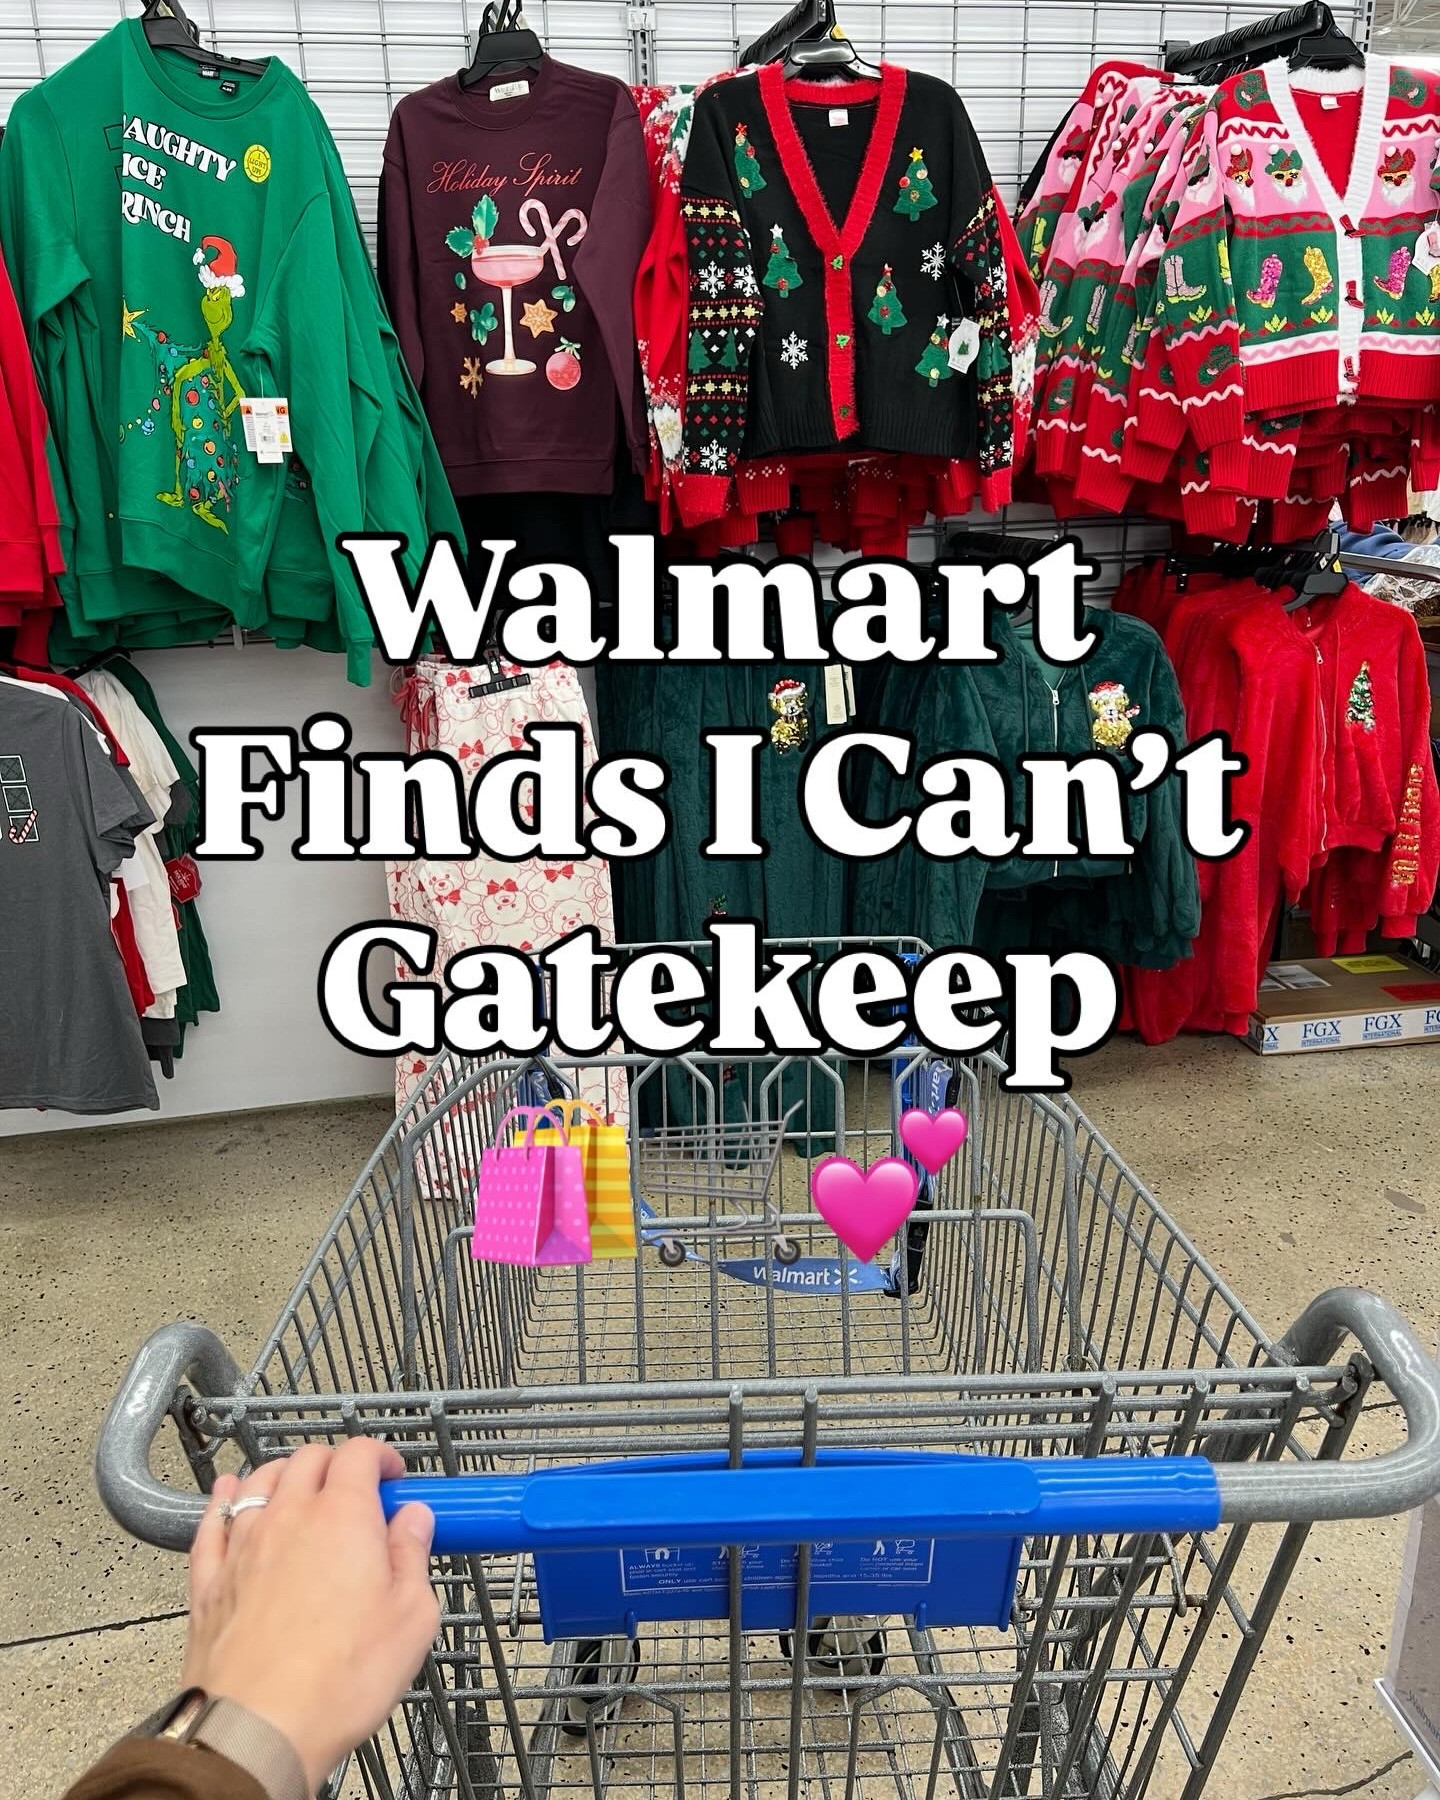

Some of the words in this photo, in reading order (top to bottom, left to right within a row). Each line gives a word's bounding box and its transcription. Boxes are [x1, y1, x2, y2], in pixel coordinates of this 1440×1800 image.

[122, 112, 238, 183] AUGHTY
[249, 157, 267, 169] LIGHT
[426, 158, 508, 197] Holiday
[512, 152, 583, 197] Spirit
[1302, 1019, 1342, 1039] FGX
[1364, 1013, 1403, 1032] FGX
[1301, 1036, 1341, 1047] INTERNATIONAL
[1363, 1029, 1402, 1041] INTERNATIONAL
[753, 1266, 830, 1286] Walmart
